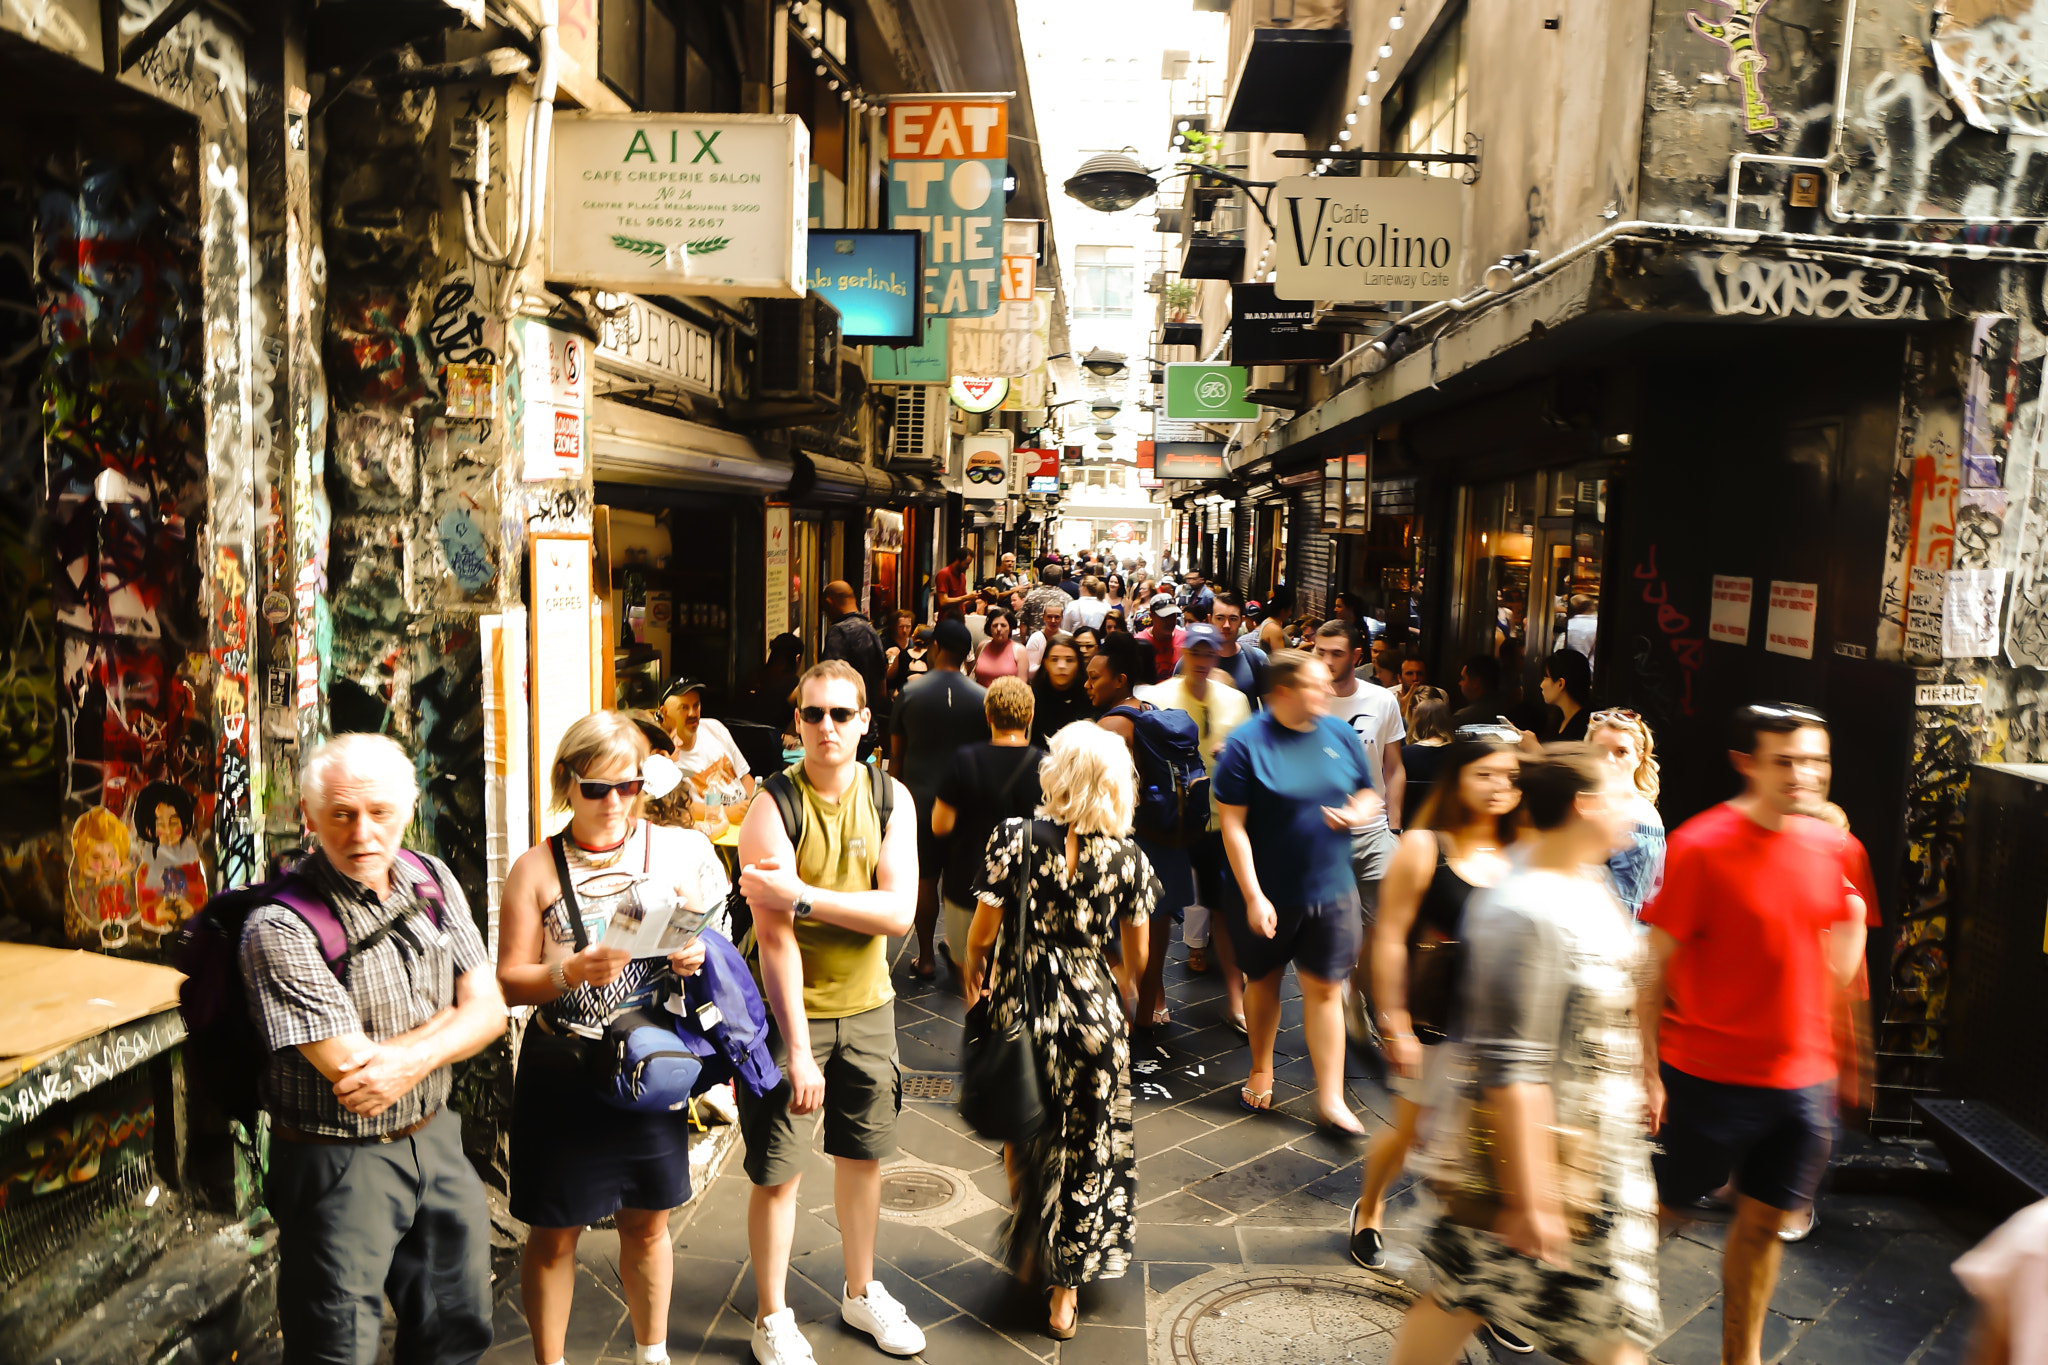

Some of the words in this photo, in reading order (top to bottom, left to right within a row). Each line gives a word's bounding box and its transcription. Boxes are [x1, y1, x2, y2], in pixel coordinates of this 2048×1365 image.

[893, 105, 999, 156] EAT
[622, 128, 723, 164] AIX
[582, 169, 622, 182] CAFE
[627, 171, 704, 183] CREPERIE
[709, 172, 761, 184] SALON
[893, 160, 992, 210] TO
[647, 217, 682, 228] 9662
[688, 218, 724, 228] 2667
[1332, 203, 1369, 224] Cafe
[1284, 197, 1451, 269] Vicolino
[1363, 271, 1417, 289] Laneway
[1421, 271, 1449, 287] Cafe
[554, 415, 580, 437] LOADING
[555, 434, 580, 455] ZONE
[545, 596, 582, 612] CREPES
